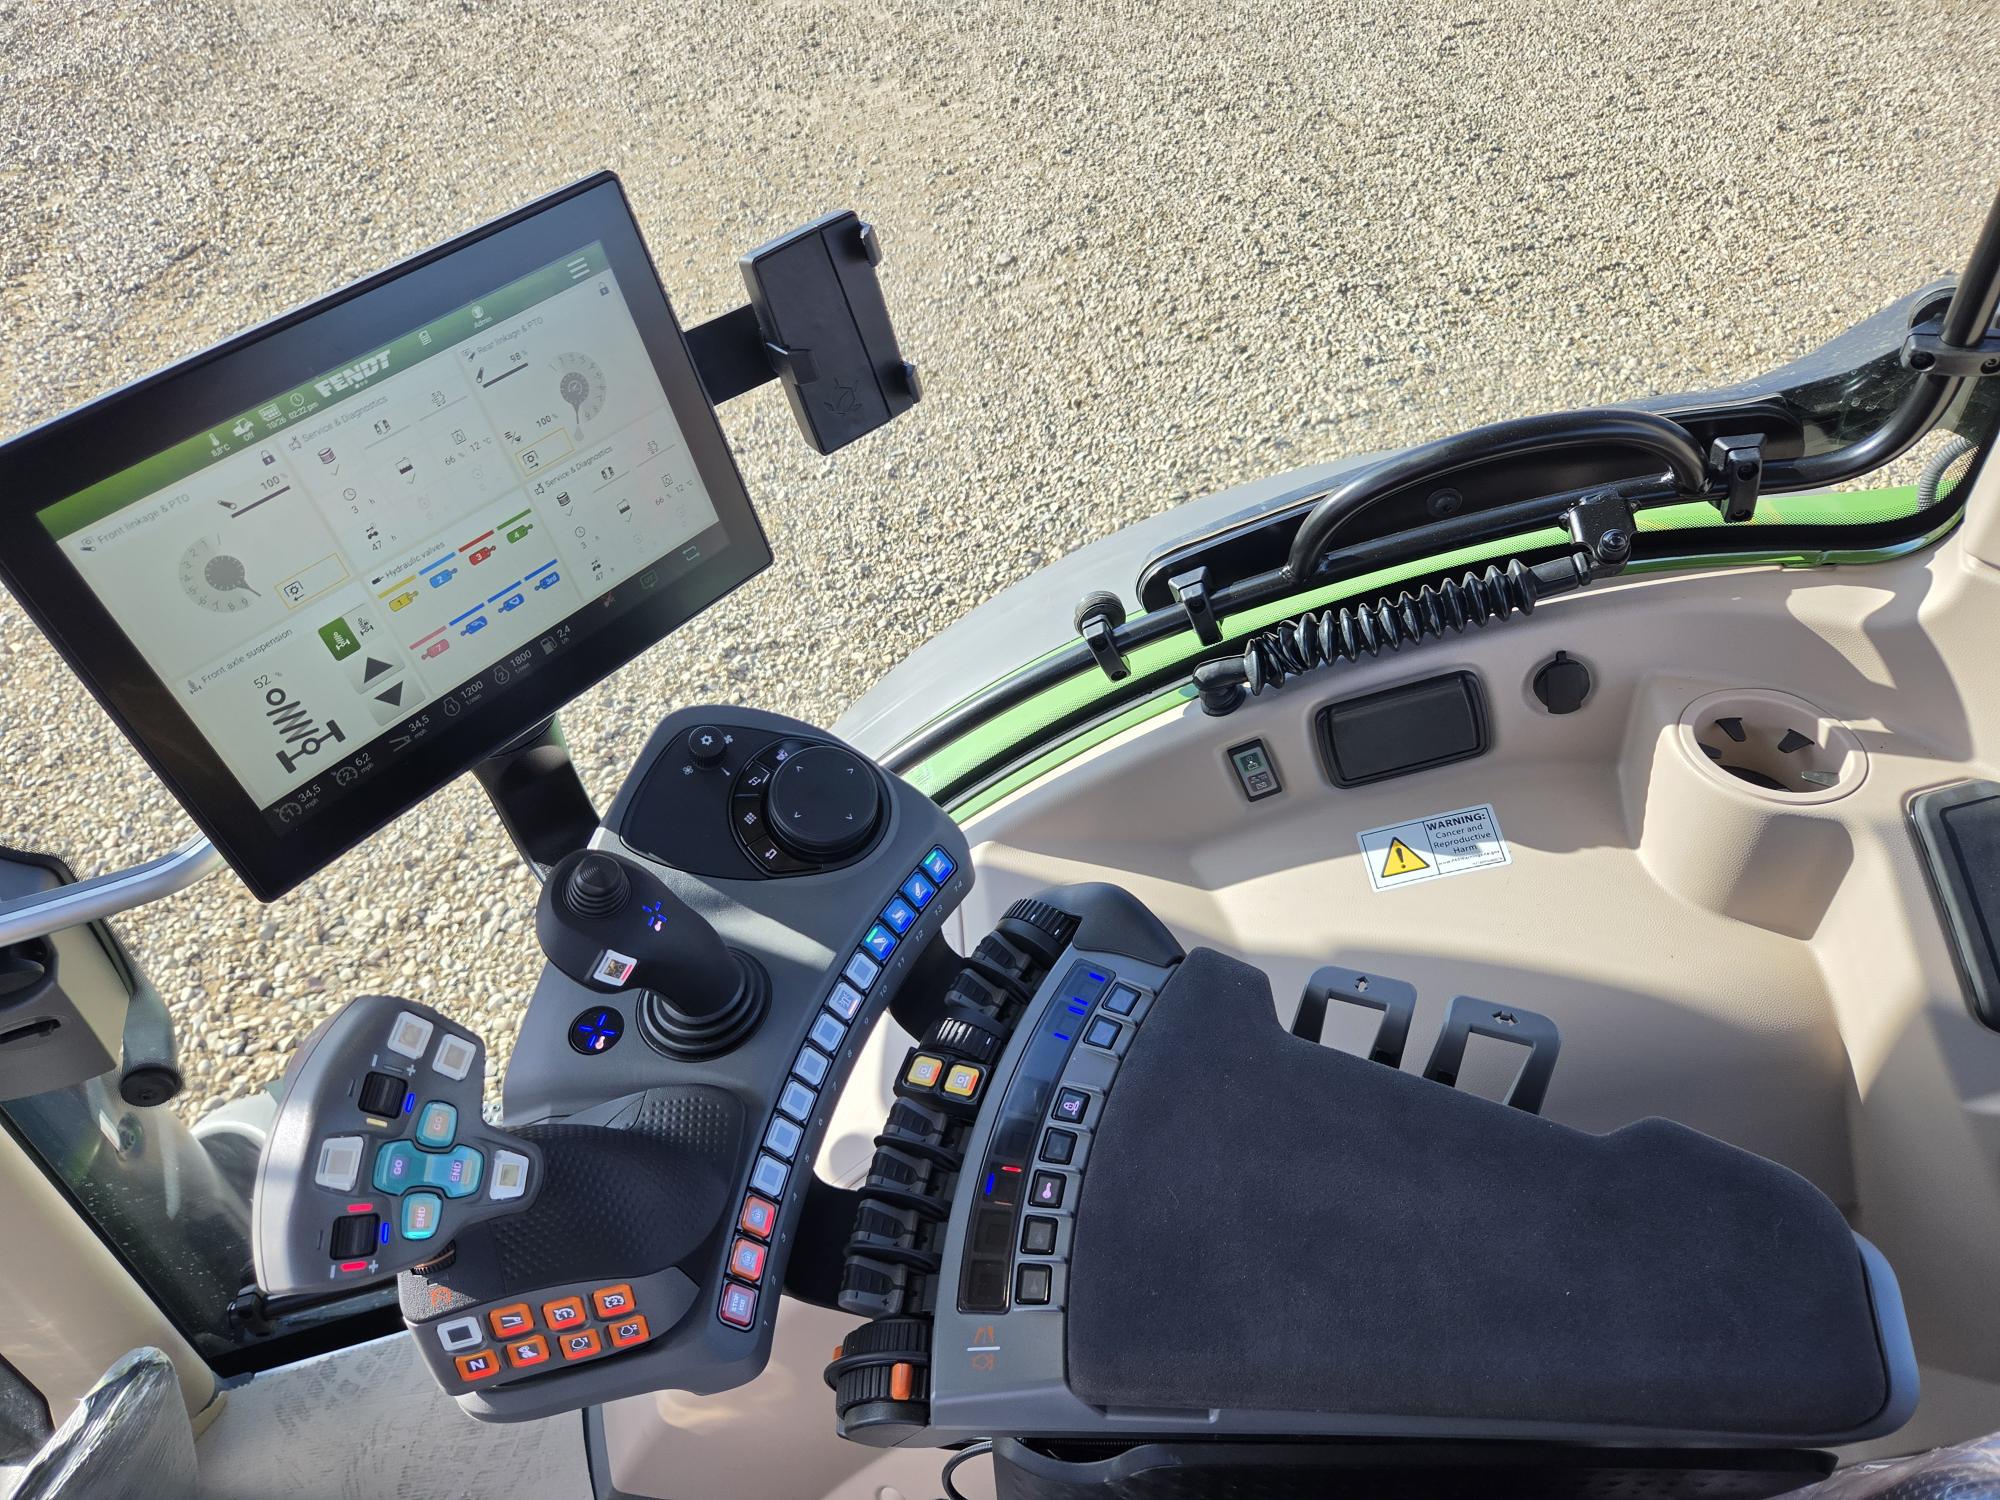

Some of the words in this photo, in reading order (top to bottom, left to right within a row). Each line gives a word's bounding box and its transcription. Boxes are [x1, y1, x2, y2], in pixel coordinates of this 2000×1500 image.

[528, 316, 544, 329] PTO
[510, 352, 521, 363] 98
[314, 349, 391, 398] FENDT
[302, 424, 333, 442] Service
[341, 396, 388, 424] Diagnostics
[536, 415, 552, 428] 100
[444, 455, 456, 466] 66
[470, 441, 481, 452] 12
[544, 471, 571, 488] Service
[576, 446, 613, 470] Diagnostics
[260, 475, 280, 490] 100
[98, 527, 125, 545] Front
[126, 510, 160, 531] linkage
[169, 494, 190, 510] PTO
[514, 531, 520, 539] 4
[372, 540, 383, 551] 47
[385, 555, 420, 579] Hydraulic
[420, 541, 446, 559] valves
[476, 553, 483, 561] 3
[437, 576, 444, 584] 2
[556, 625, 571, 638] 2,4
[201, 666, 226, 683] Front
[226, 654, 245, 670] axle
[245, 628, 294, 659] suspension
[510, 649, 532, 667] 1800
[253, 674, 271, 689] 52
[460, 680, 484, 699] 1200
[408, 714, 430, 732] 34,5
[355, 752, 372, 766] 6,2
[360, 763, 374, 774] mph
[298, 783, 321, 803] 34,5
[304, 798, 319, 809] mph
[1426, 812, 1486, 831] WARNING:
[1435, 828, 1465, 839] Cancer
[1467, 823, 1483, 834] and
[1433, 832, 1491, 849] Reproductive
[1453, 844, 1478, 855] Harm
[393, 1159, 403, 1175] GO
[451, 1161, 462, 1183] END
[470, 1358, 485, 1371] N
